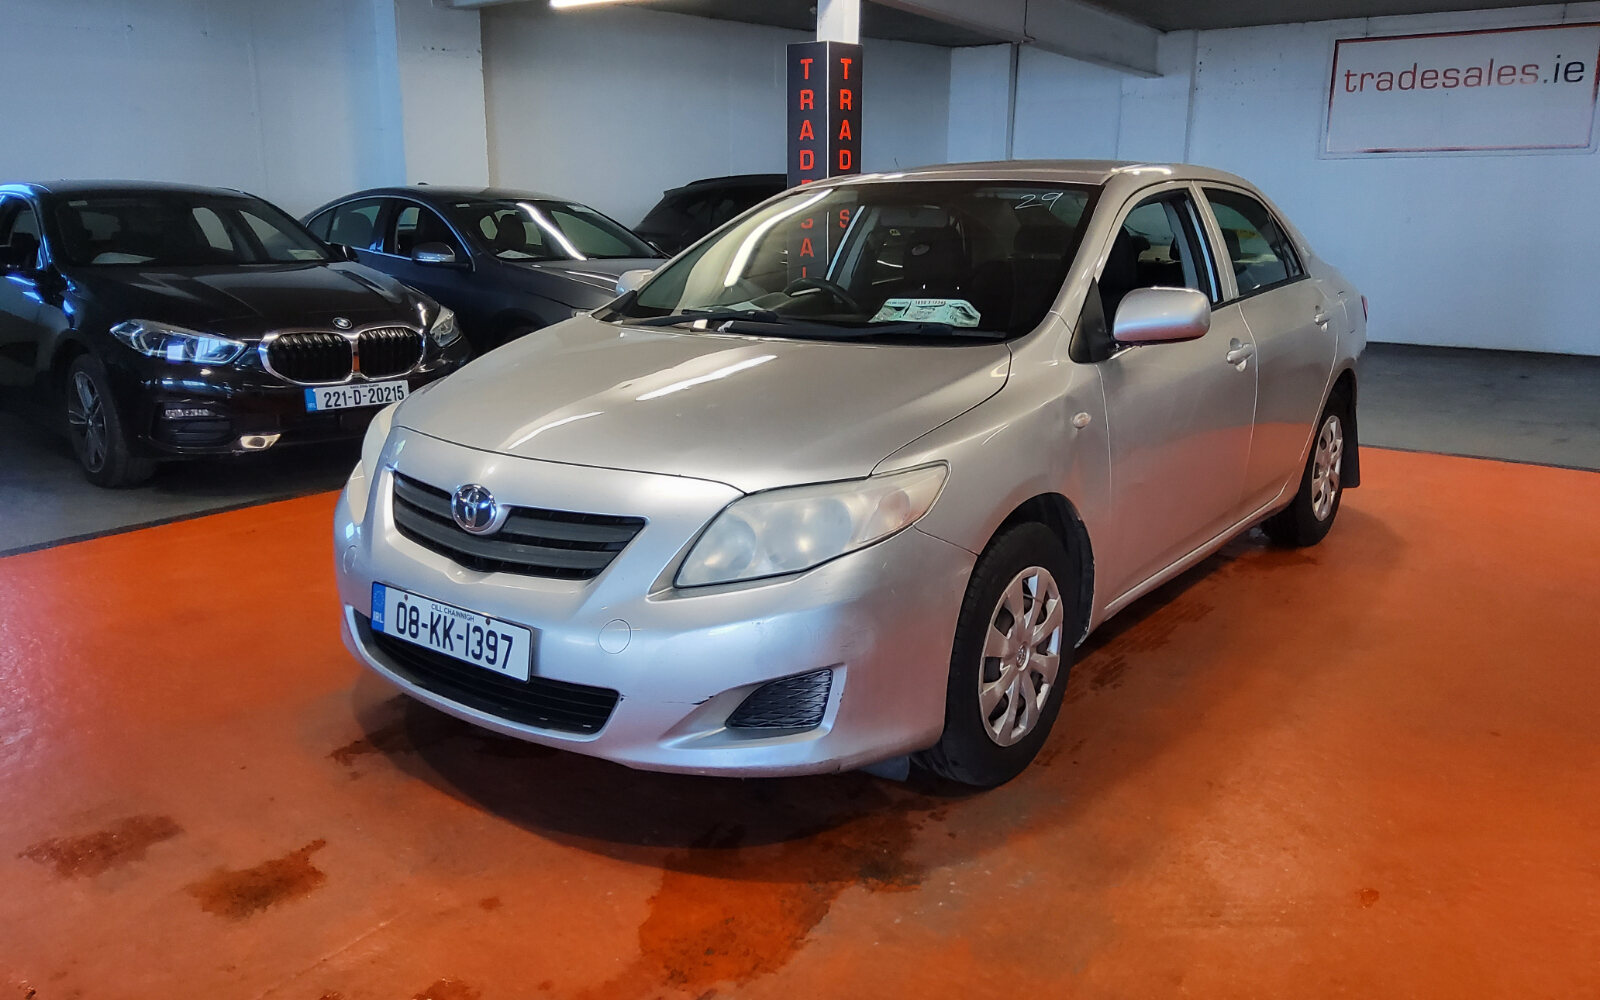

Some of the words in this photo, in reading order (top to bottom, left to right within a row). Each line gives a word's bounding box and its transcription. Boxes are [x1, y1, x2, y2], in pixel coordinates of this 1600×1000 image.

[1344, 55, 1585, 93] tradesales.ie
[799, 57, 815, 185] TRAD
[838, 57, 852, 171] TRAD
[1014, 192, 1064, 211] 29
[323, 385, 405, 408] 221-D-20215
[372, 610, 384, 624] IRL
[431, 603, 443, 613] CILL
[396, 601, 513, 669] 08-KK-1397
